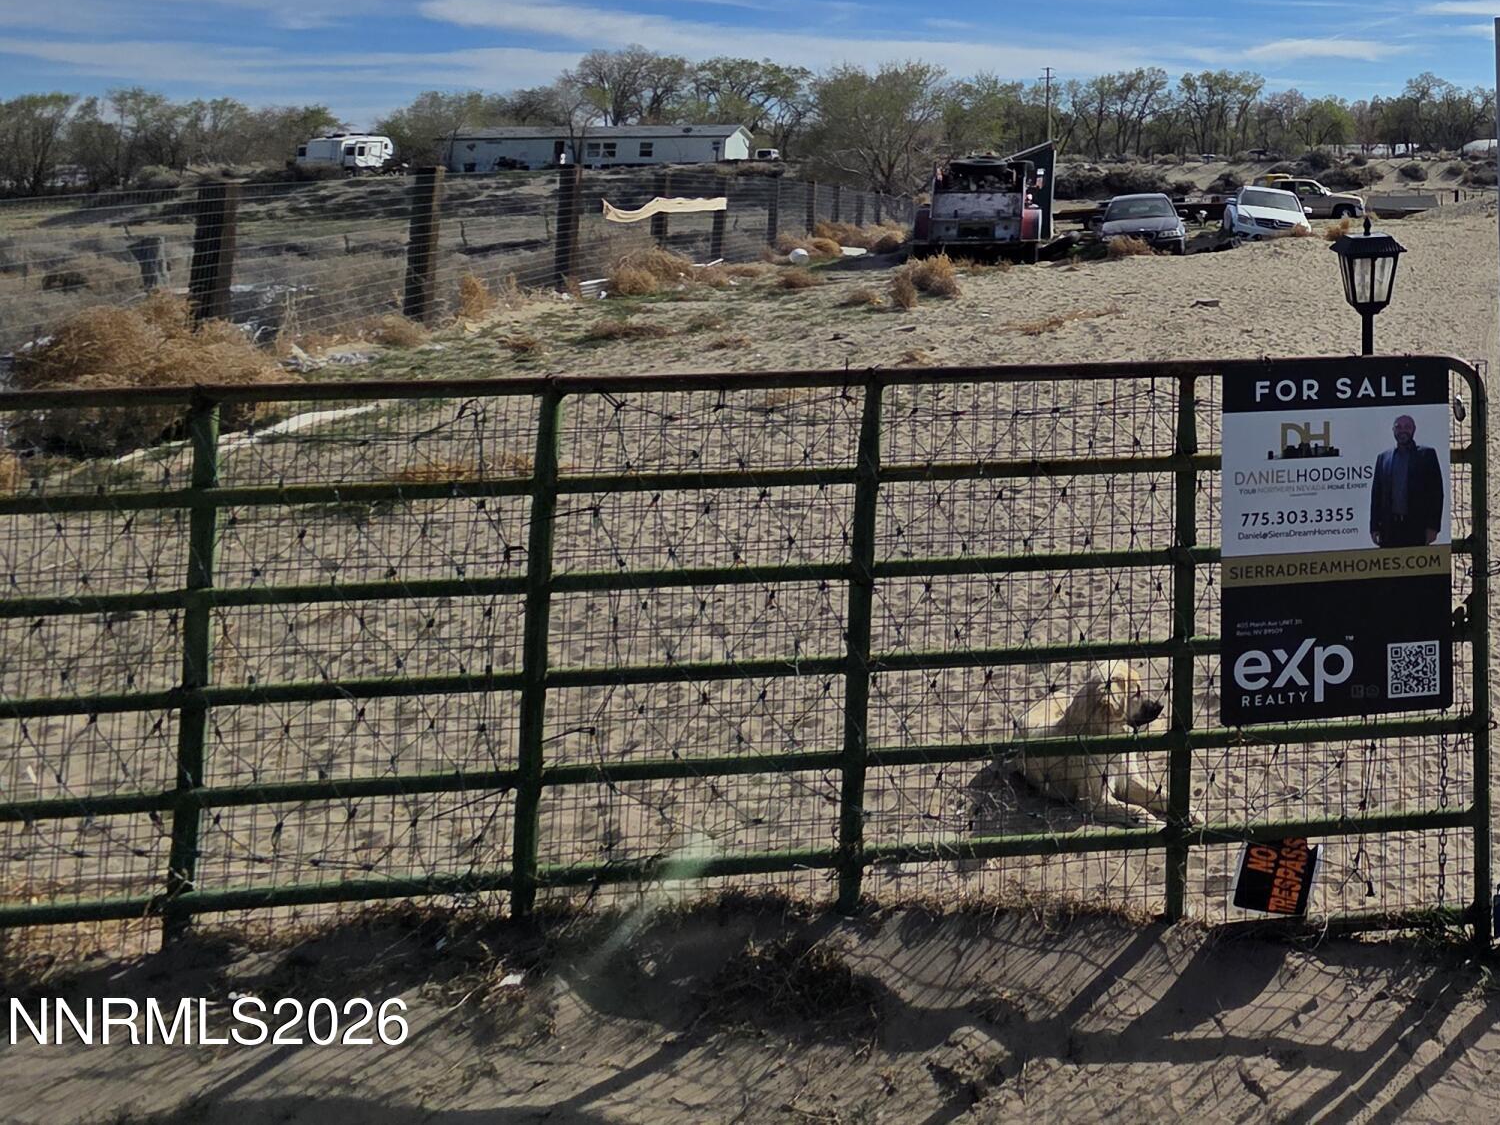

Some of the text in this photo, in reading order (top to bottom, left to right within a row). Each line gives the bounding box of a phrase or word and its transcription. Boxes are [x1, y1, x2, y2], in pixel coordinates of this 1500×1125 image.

[1255, 375, 1417, 403] FOR SALE
[1280, 421, 1331, 452] DH
[1240, 506, 1355, 528] 775.303.3355
[1237, 525, 1359, 541] Daniel@SierraDreamHomes.com
[1229, 554, 1442, 581] SIERRADREAMHOMES.COM
[1241, 691, 1308, 708] REALTY
[1247, 847, 1278, 874] NO
